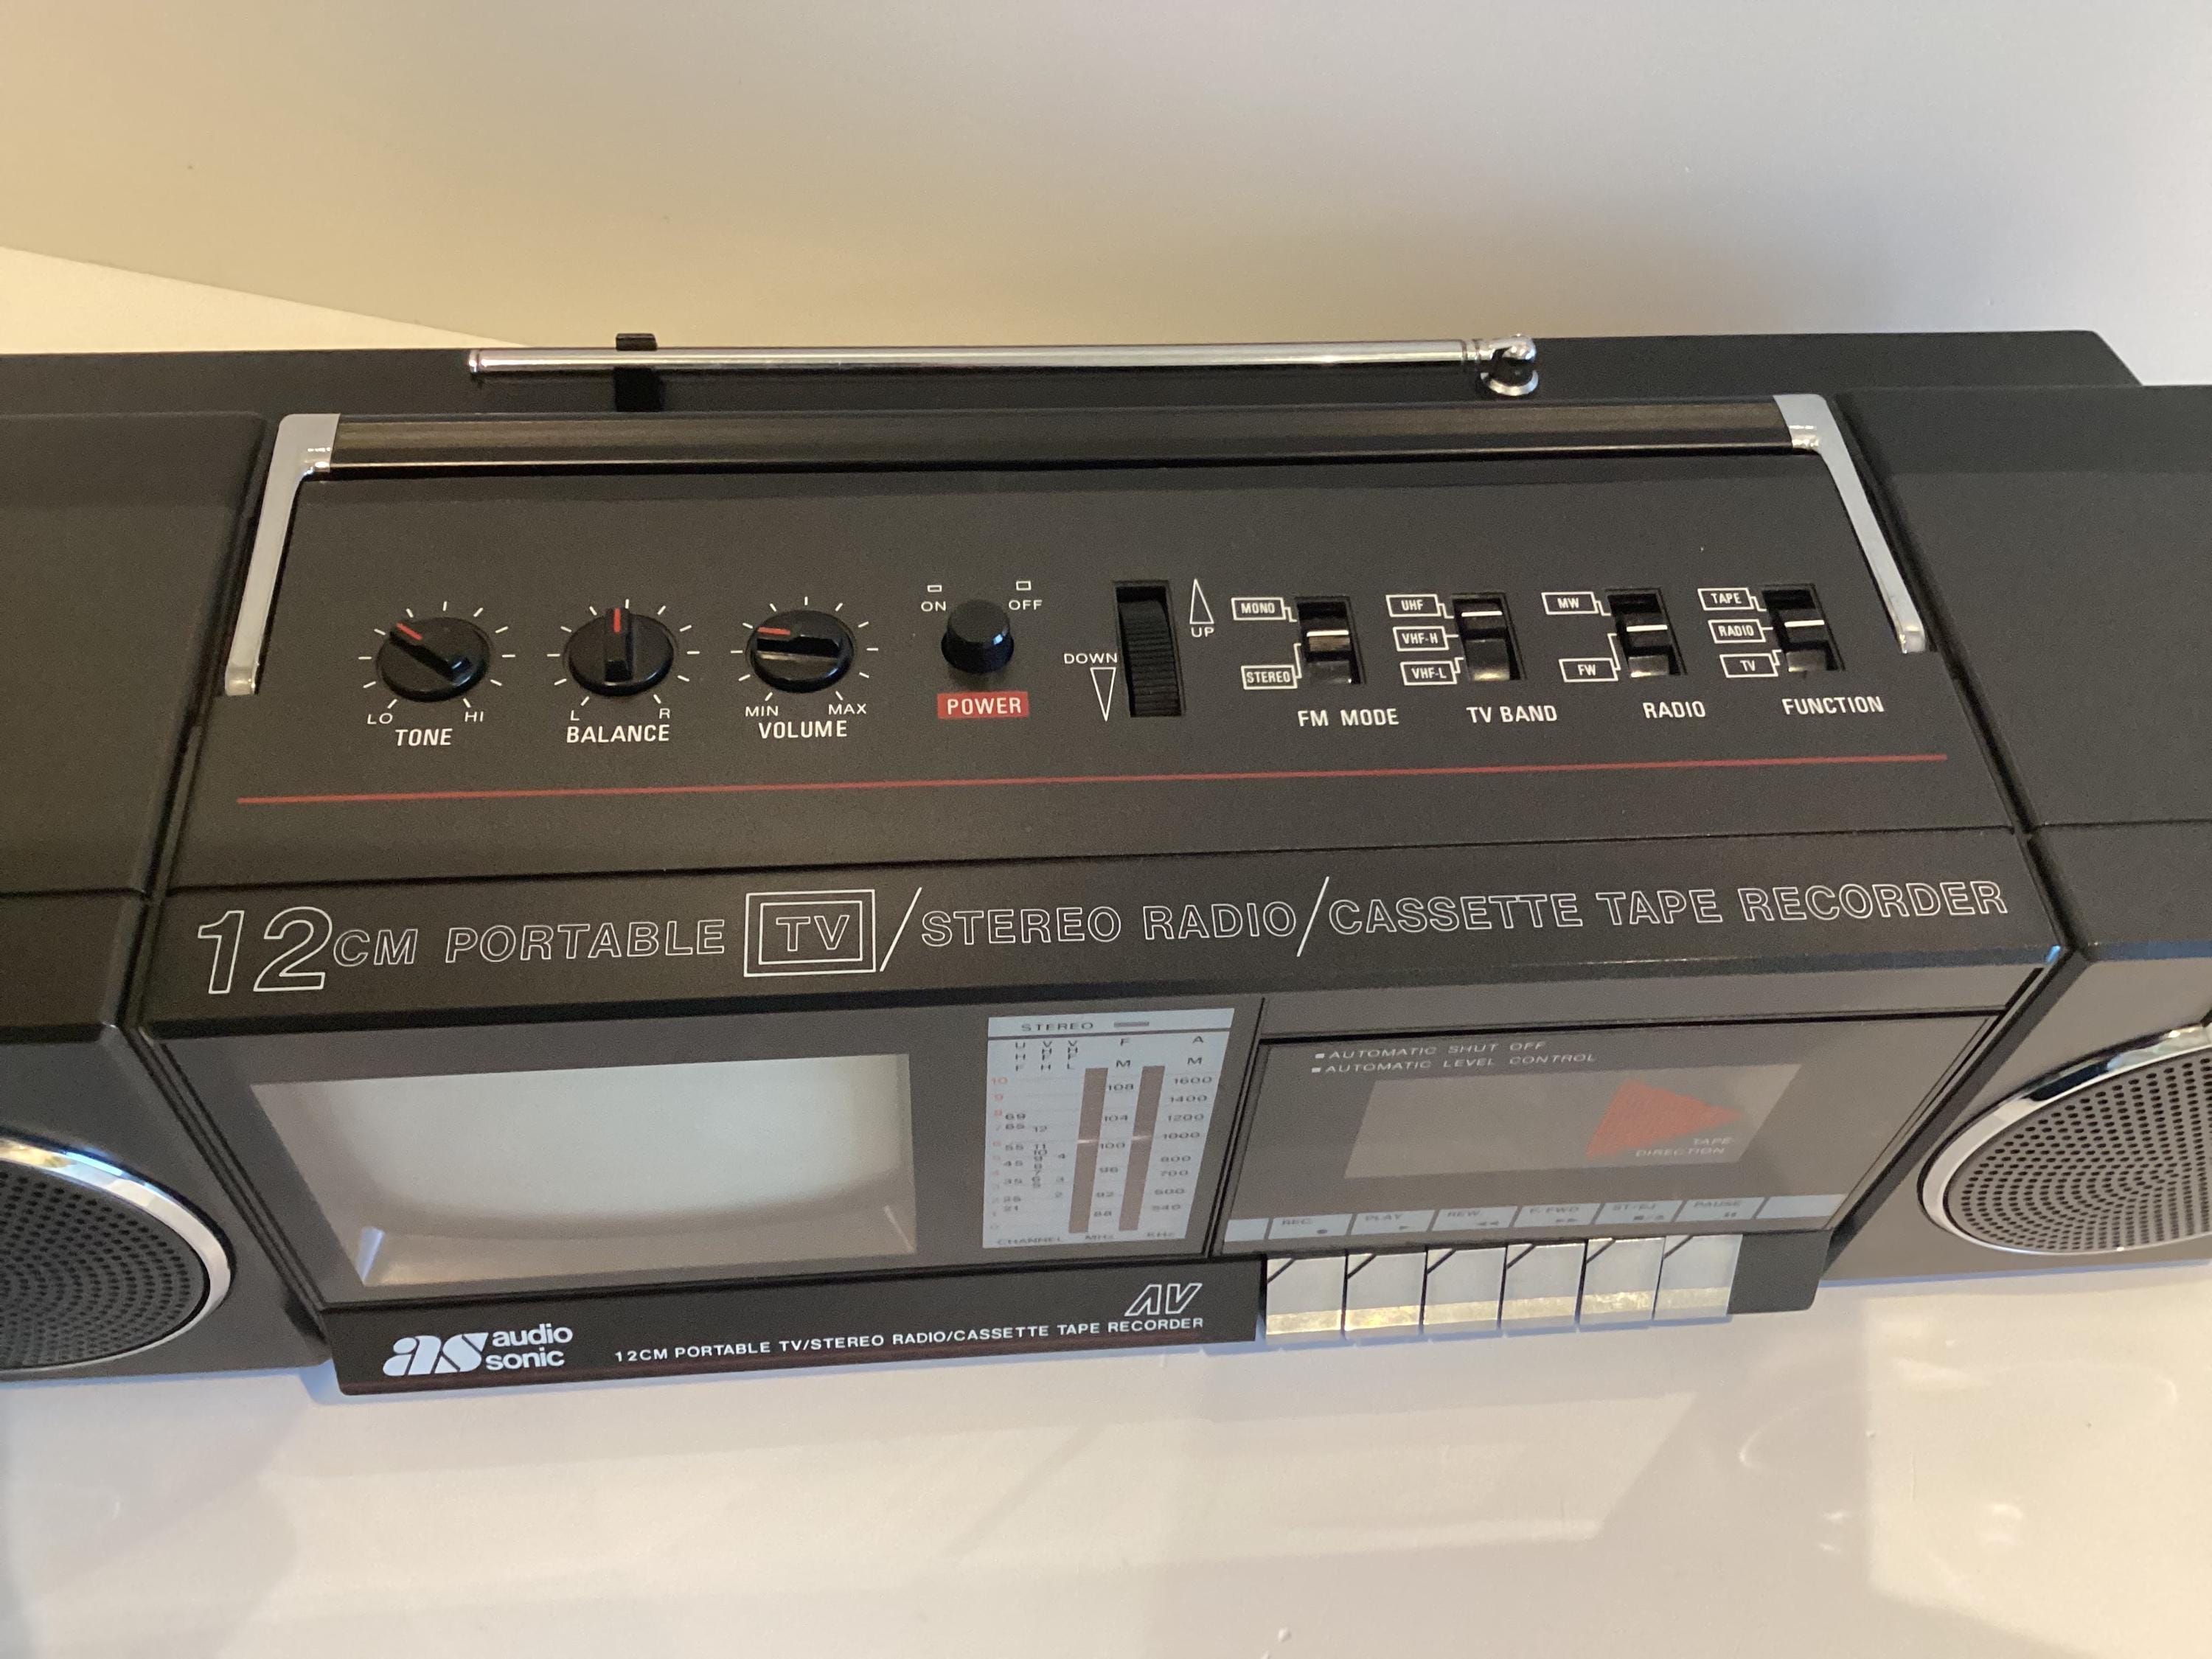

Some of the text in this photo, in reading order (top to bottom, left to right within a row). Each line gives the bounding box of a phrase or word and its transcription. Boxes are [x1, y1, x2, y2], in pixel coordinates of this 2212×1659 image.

[1008, 599, 1043, 611] OFF
[1401, 598, 1424, 611] UHF
[1557, 597, 1580, 610] MW
[1710, 593, 1742, 605] TAPE
[920, 600, 947, 612] ON
[1240, 602, 1276, 615] MONO
[1190, 626, 1215, 638] UP
[1402, 631, 1439, 645] VHF-H
[1719, 625, 1754, 639] RADIO
[1063, 653, 1119, 664] DOWN
[1577, 664, 1597, 676] FW
[1740, 659, 1756, 672] TV
[1246, 669, 1291, 684] STEREO
[1411, 666, 1447, 680] VHF-L
[745, 706, 779, 717] MIN
[828, 703, 867, 716] MAX
[947, 698, 1022, 716] POWER
[1643, 701, 1706, 720] RADIO
[1781, 696, 1885, 716] FUNCTION
[367, 713, 394, 725] LO
[465, 712, 484, 723] HI
[570, 710, 580, 720] L
[658, 708, 671, 720] R
[1297, 708, 1399, 726] FM MODE
[1466, 705, 1558, 723] TV BAND
[566, 724, 670, 744] BALANCE
[758, 720, 848, 740] VOLUME
[394, 728, 453, 747] TONE
[197, 905, 419, 995] 12CM
[445, 919, 726, 964] PORTABLE
[776, 914, 850, 953] TV
[1595, 888, 1723, 925] TAPE
[1737, 880, 2009, 923] RECORDER
[1021, 1022, 1093, 1032] STEREO
[1329, 1040, 1548, 1060] AUTOMATIC SHUT OFF
[1325, 1053, 1596, 1074] AUTOMATIC LEVEL CONTROL
[1694, 1137, 1733, 1146] TAPE
[1635, 1147, 1725, 1158] DIRECTION
[492, 1324, 574, 1348] audio
[615, 1317, 1204, 1362] 12CM PORTABLE TV/STEREO RADIO/CASSETTE TAPE RECORDER
[485, 1348, 566, 1371] sonic
